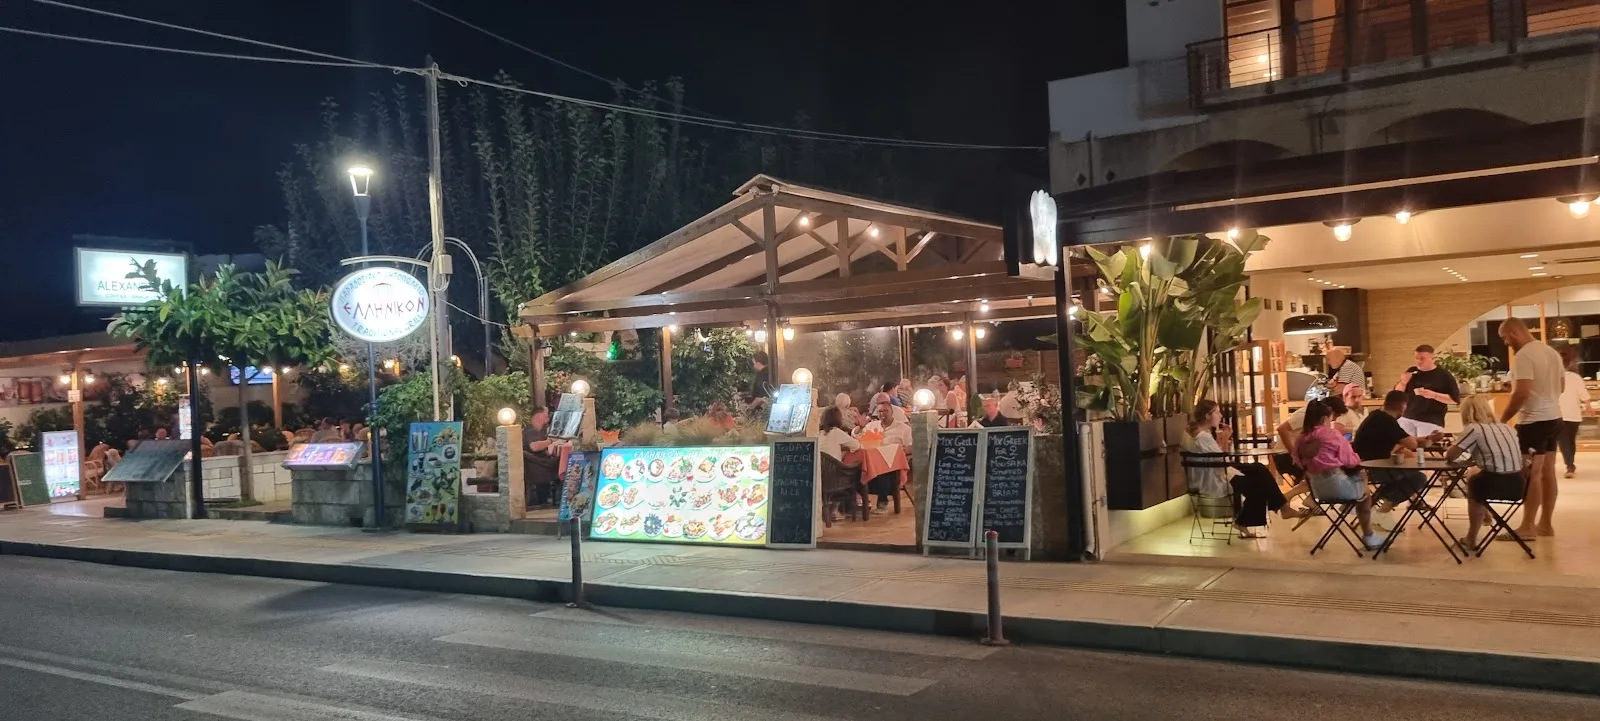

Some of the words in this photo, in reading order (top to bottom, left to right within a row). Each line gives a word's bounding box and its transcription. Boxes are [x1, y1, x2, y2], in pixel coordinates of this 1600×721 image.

[954, 435, 978, 446] GRILL
[1003, 435, 1027, 446] GREEK
[776, 443, 812, 452] TODAY
[957, 446, 967, 457] 2
[1009, 445, 1018, 456] 2
[775, 453, 812, 463] SPECIAL
